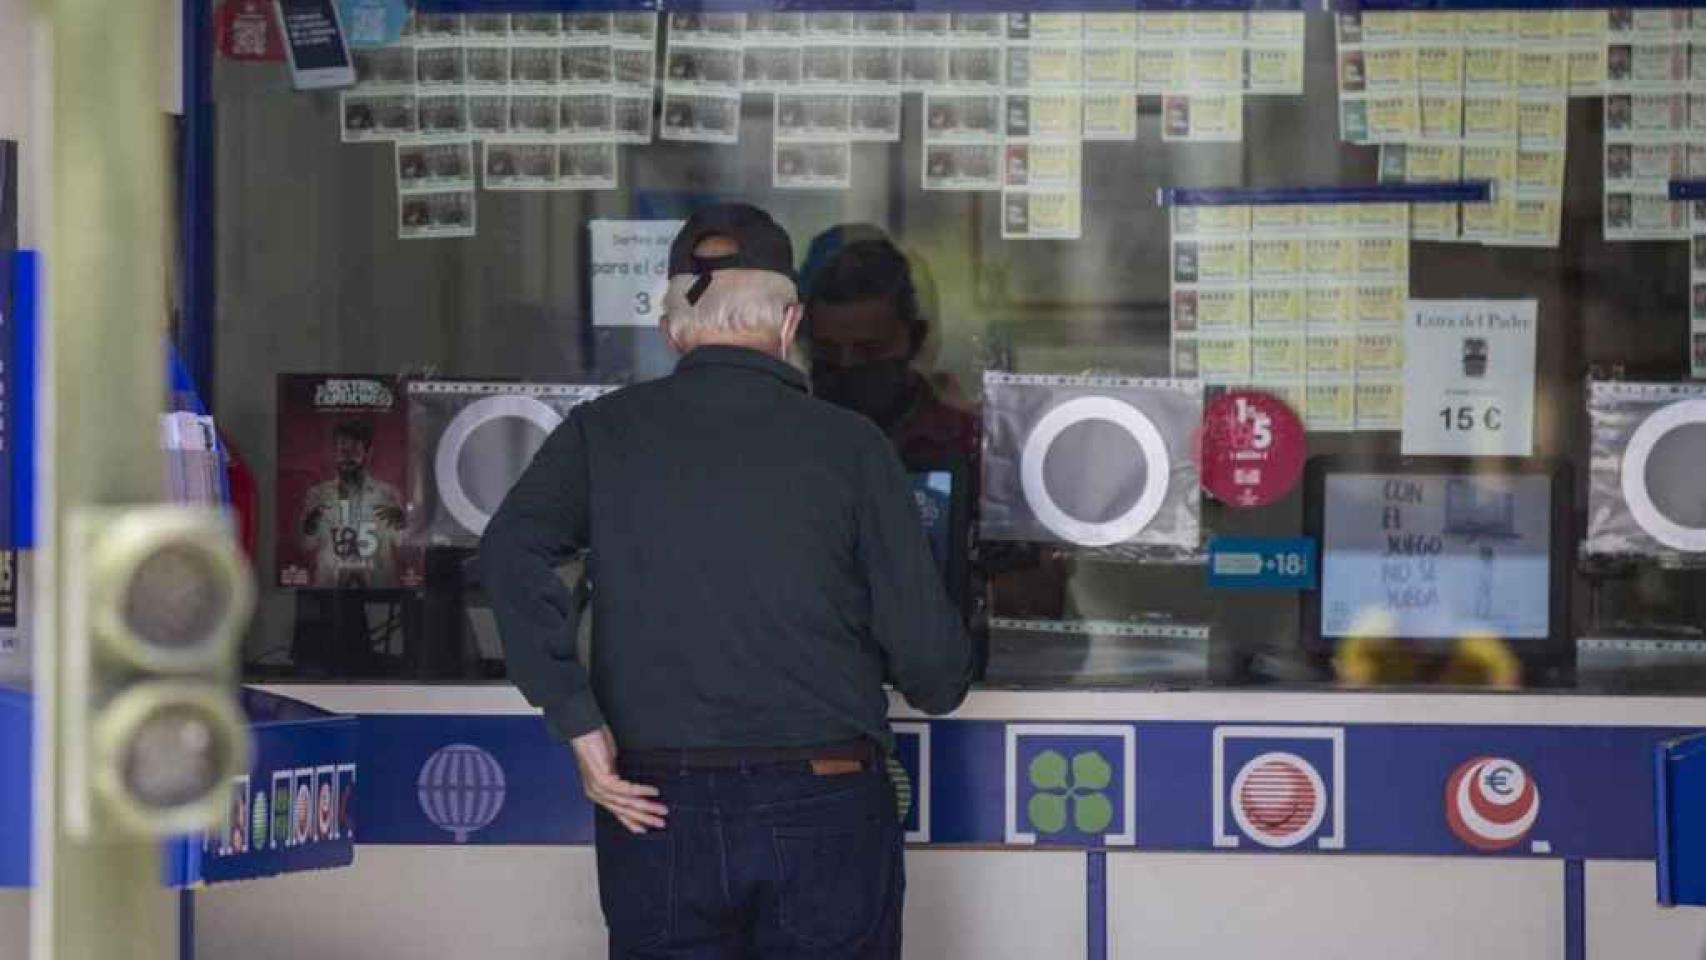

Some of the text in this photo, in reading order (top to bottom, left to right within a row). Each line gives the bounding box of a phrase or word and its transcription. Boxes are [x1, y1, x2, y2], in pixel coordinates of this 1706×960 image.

[592, 260, 629, 278] para
[632, 259, 649, 275] el
[635, 292, 651, 314] 3
[1458, 312, 1483, 329] del
[1438, 405, 1501, 432] 15 €
[1383, 533, 1444, 558] JUEGO
